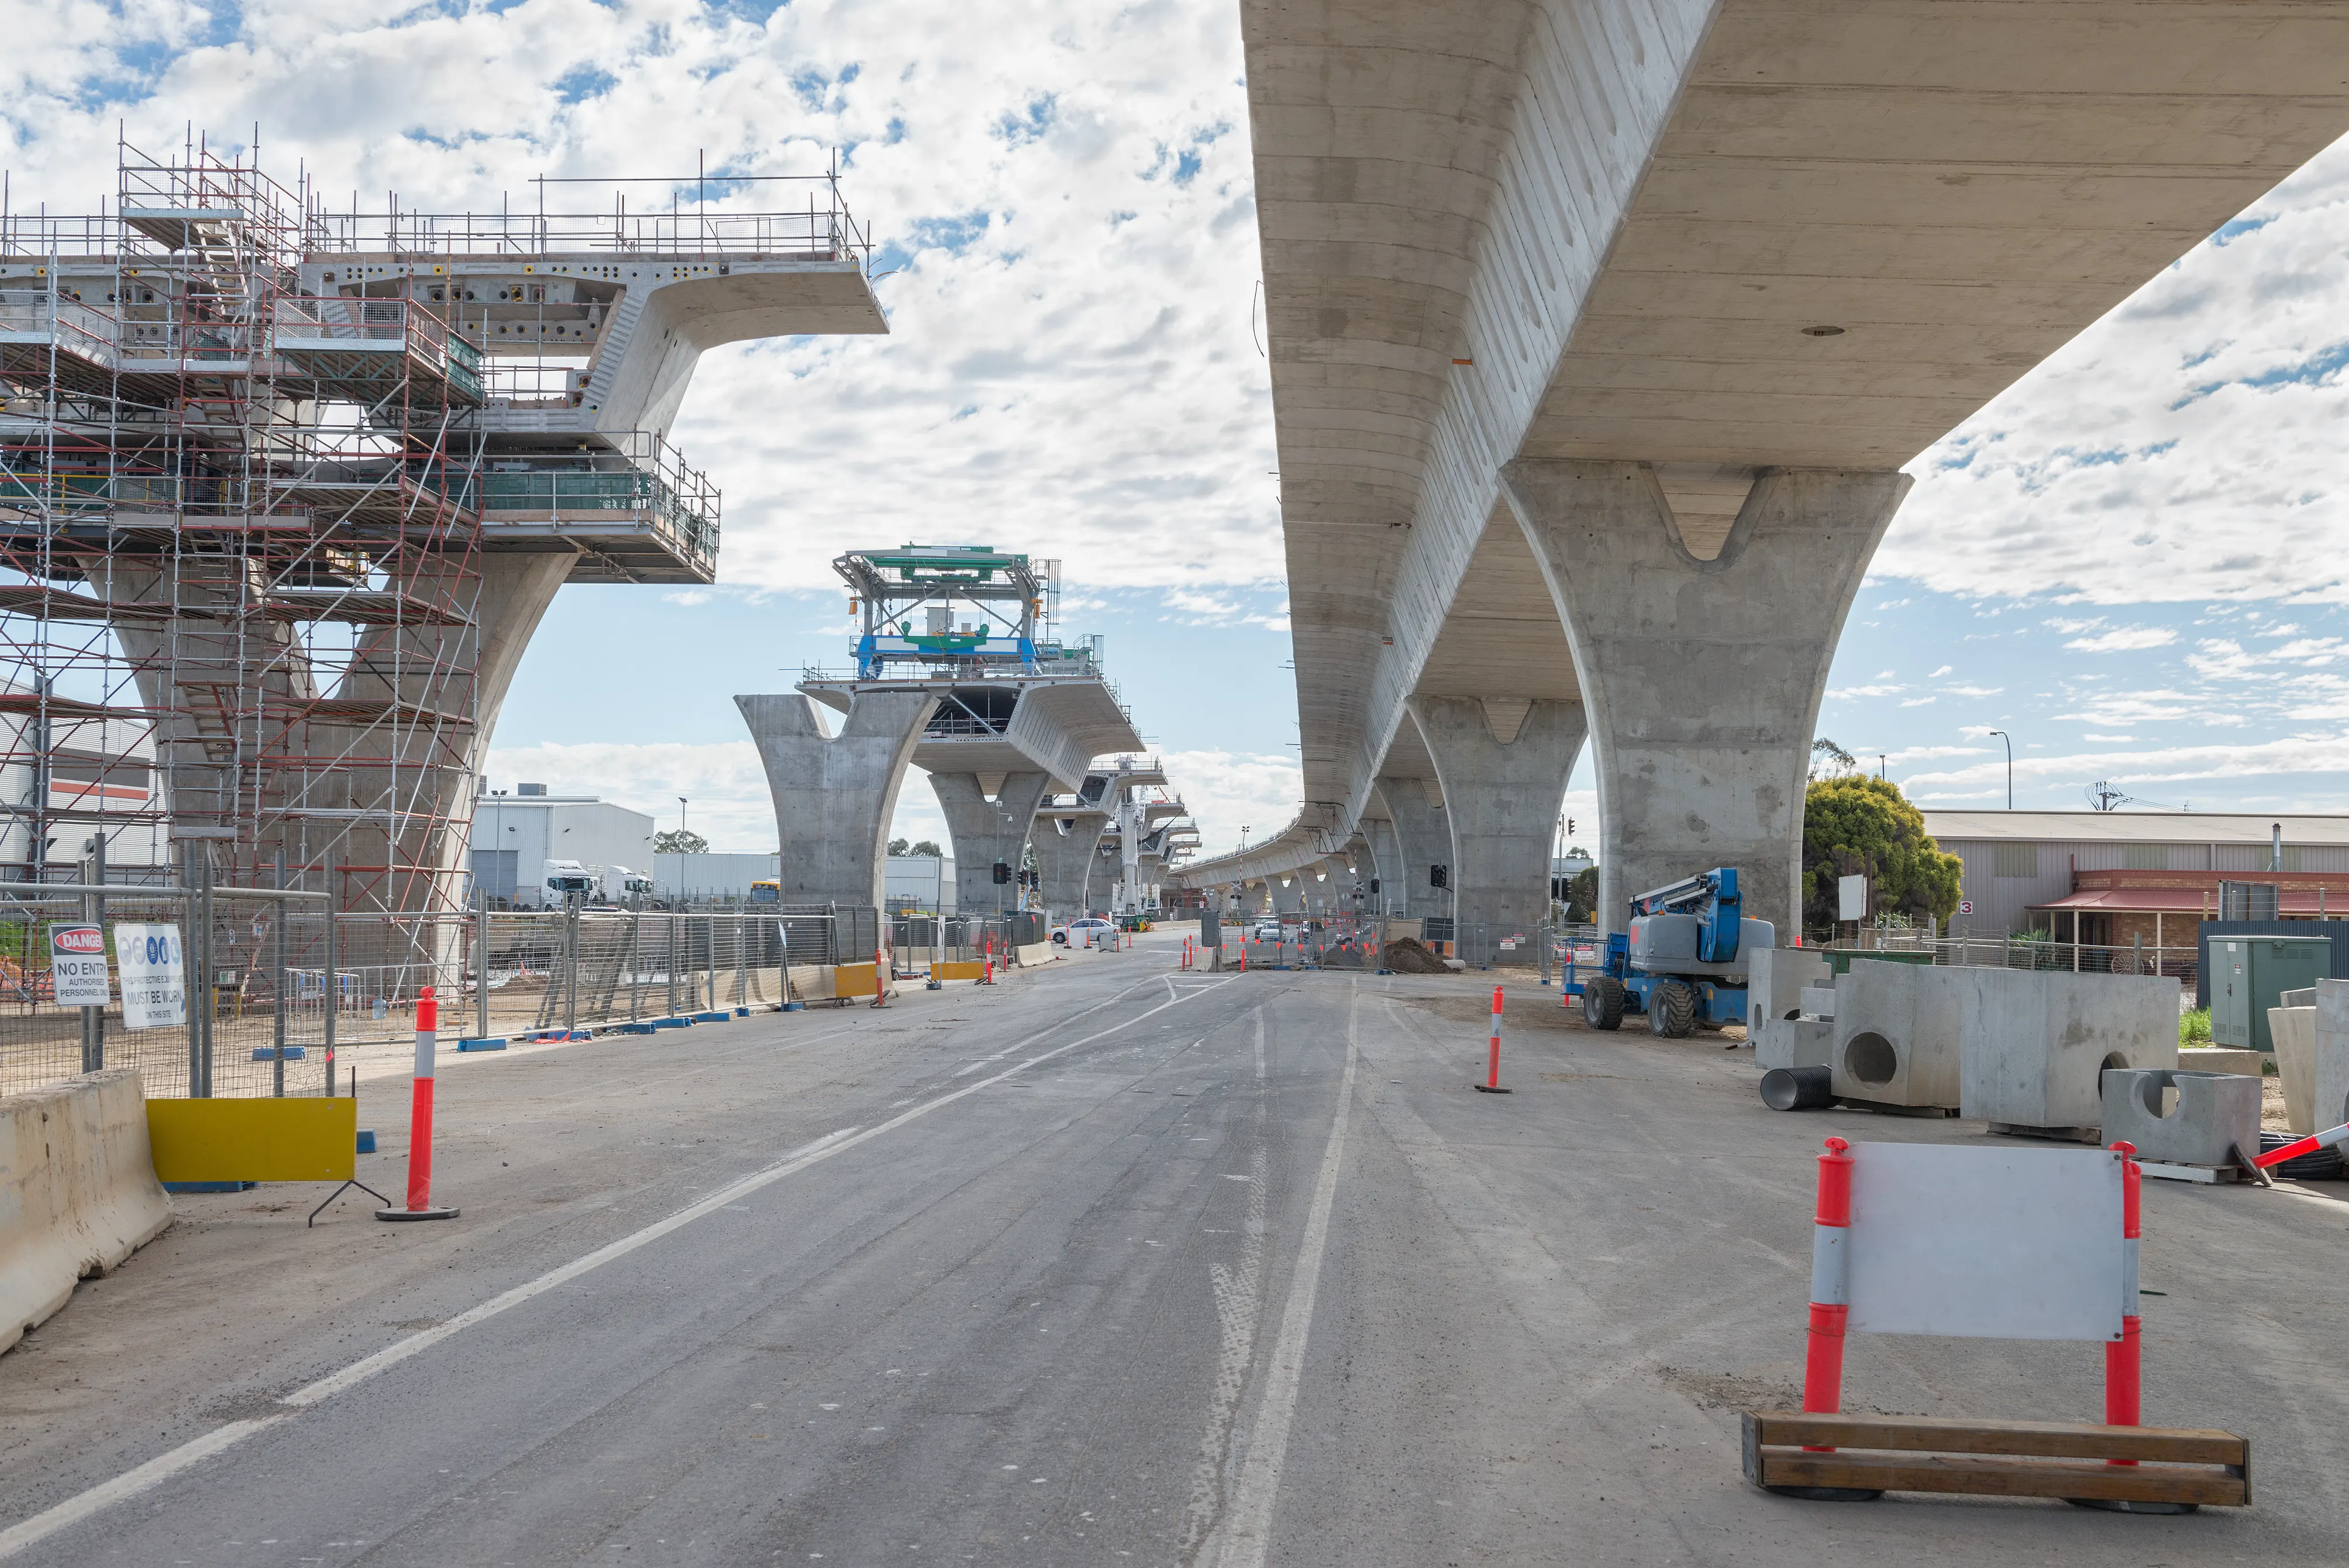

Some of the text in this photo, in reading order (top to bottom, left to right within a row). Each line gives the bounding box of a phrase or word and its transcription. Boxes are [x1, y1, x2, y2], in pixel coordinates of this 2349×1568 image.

[1961, 902, 1972, 913] 3
[63, 934, 102, 947] DANGER
[57, 963, 106, 976] NO ENTRY
[122, 975, 182, 985] THIS PROTECTIVE EQUIPMENT
[127, 990, 182, 1005] MUST BE WORN
[163, 1010, 171, 1018] SITE
